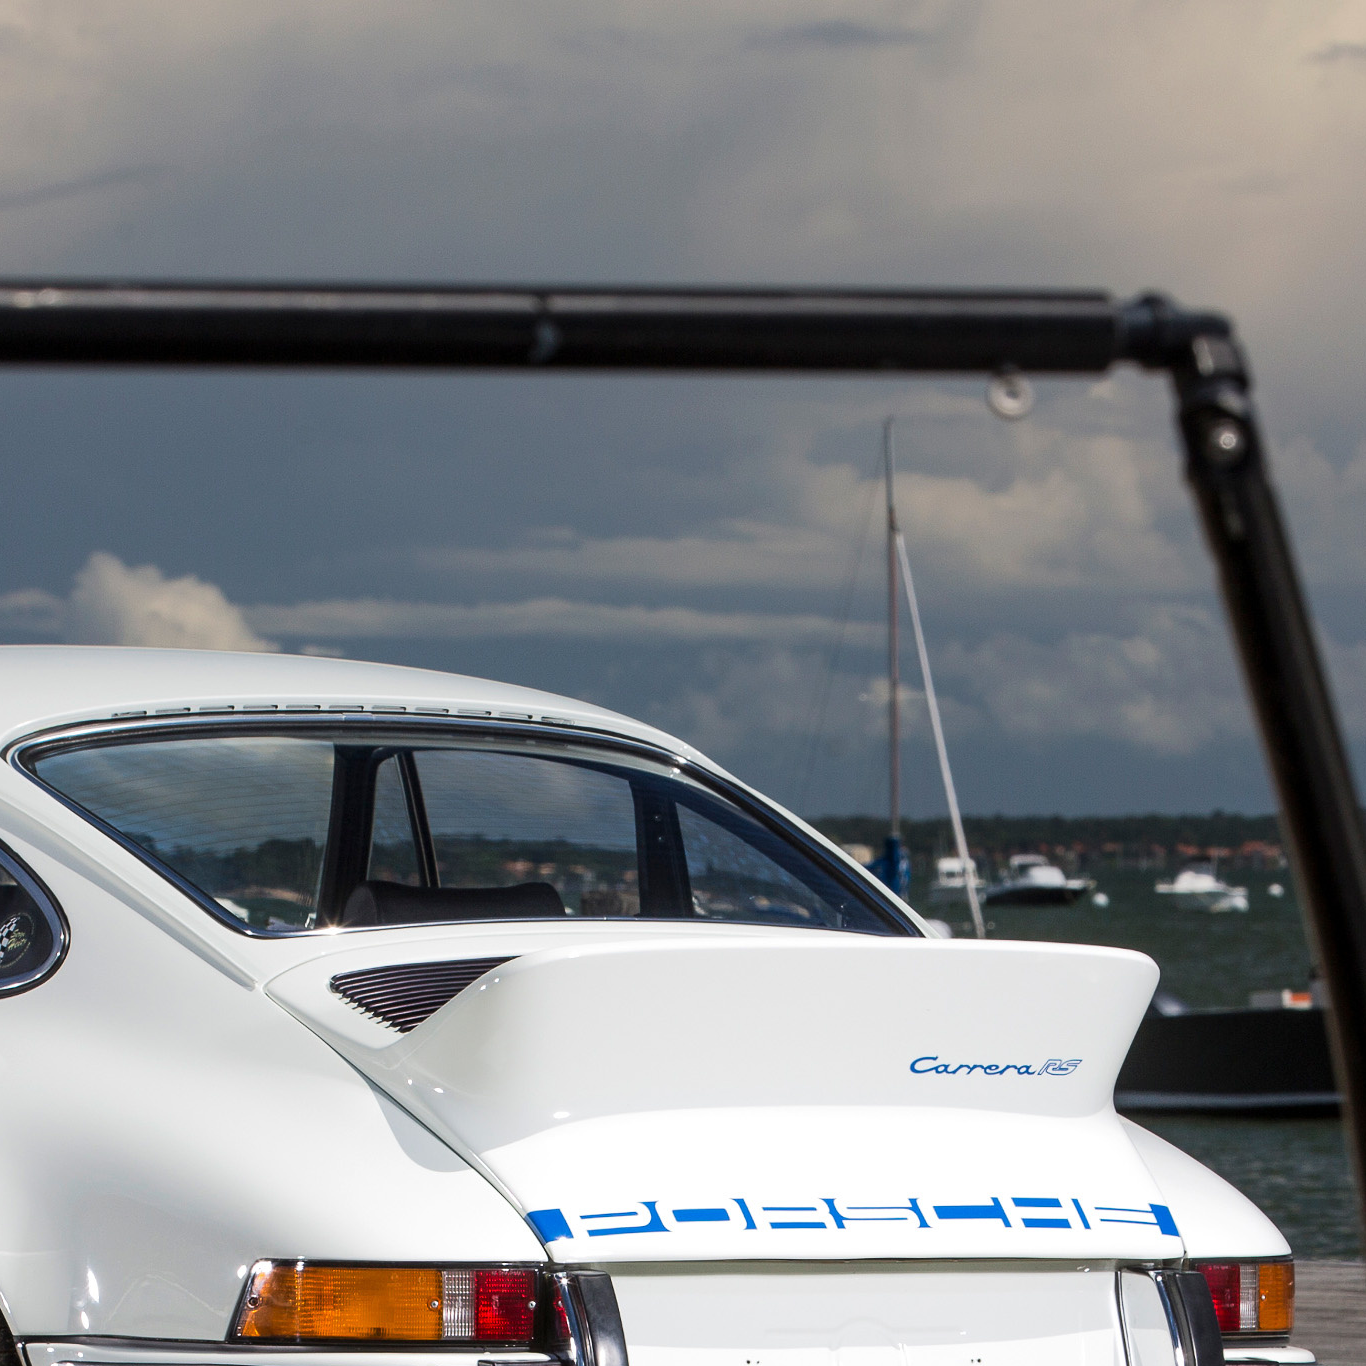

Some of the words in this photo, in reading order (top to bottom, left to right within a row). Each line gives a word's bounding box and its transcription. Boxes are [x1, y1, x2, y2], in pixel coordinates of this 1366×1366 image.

[909, 1055, 1036, 1076] Carrera
[1037, 1058, 1084, 1076] RS
[562, 1197, 1161, 1240] PORSCHE
